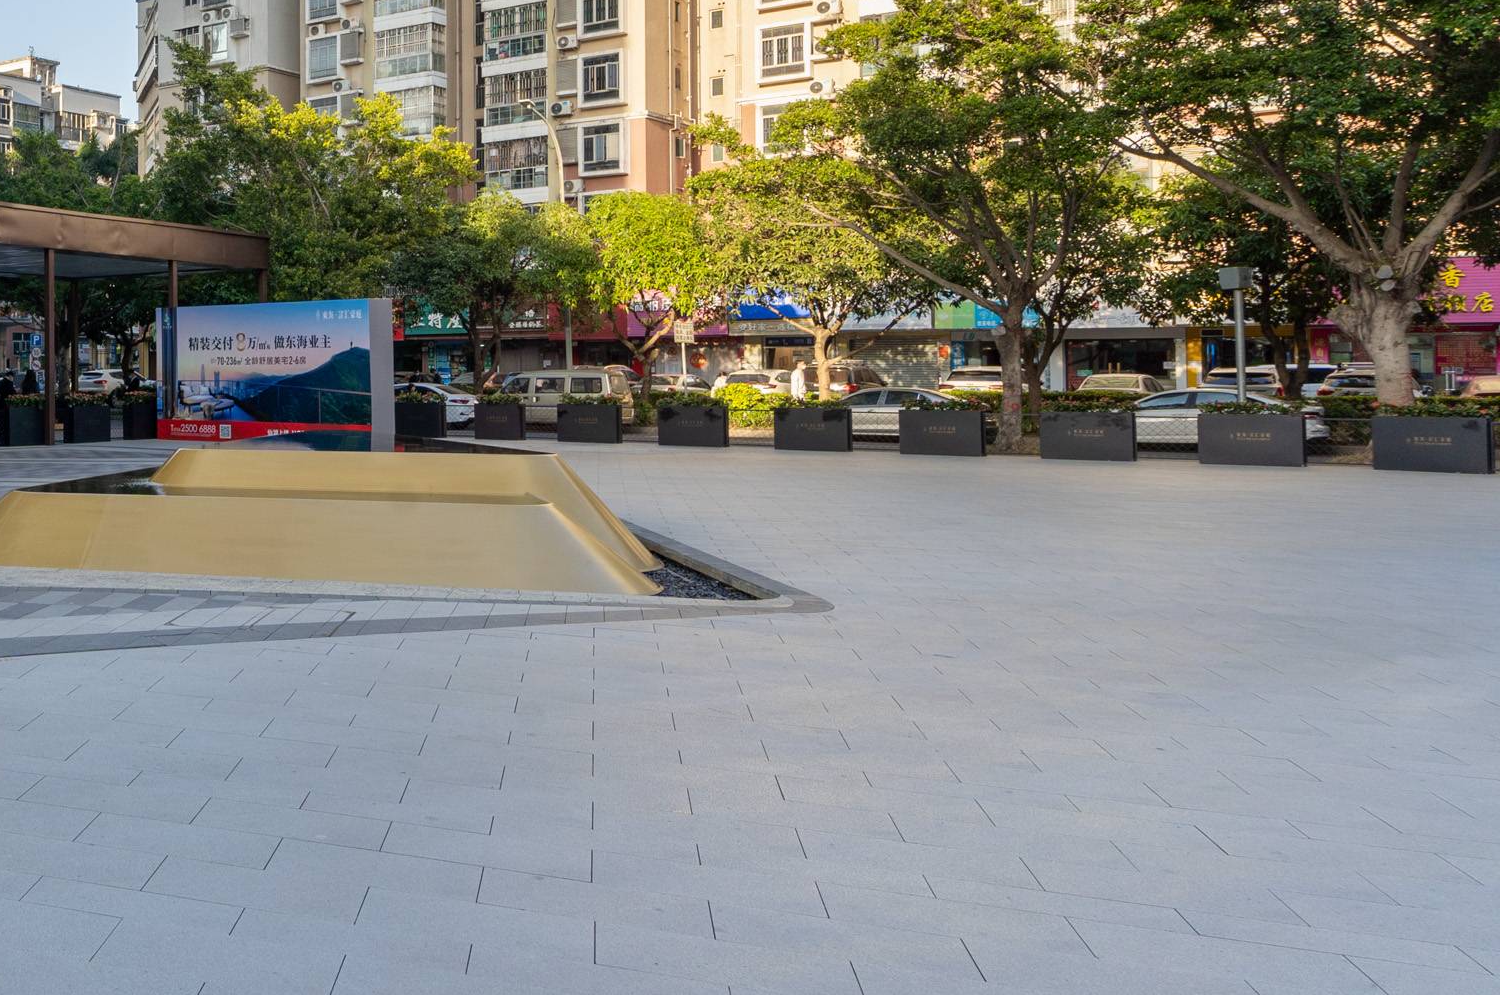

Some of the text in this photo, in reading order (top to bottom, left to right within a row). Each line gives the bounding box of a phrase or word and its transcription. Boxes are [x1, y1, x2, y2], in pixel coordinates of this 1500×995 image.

[1438, 263, 1467, 288] 香
[33, 335, 40, 345] P
[274, 334, 332, 349] 做东海业主
[180, 423, 198, 433] 2500
[199, 424, 217, 434] 6888
